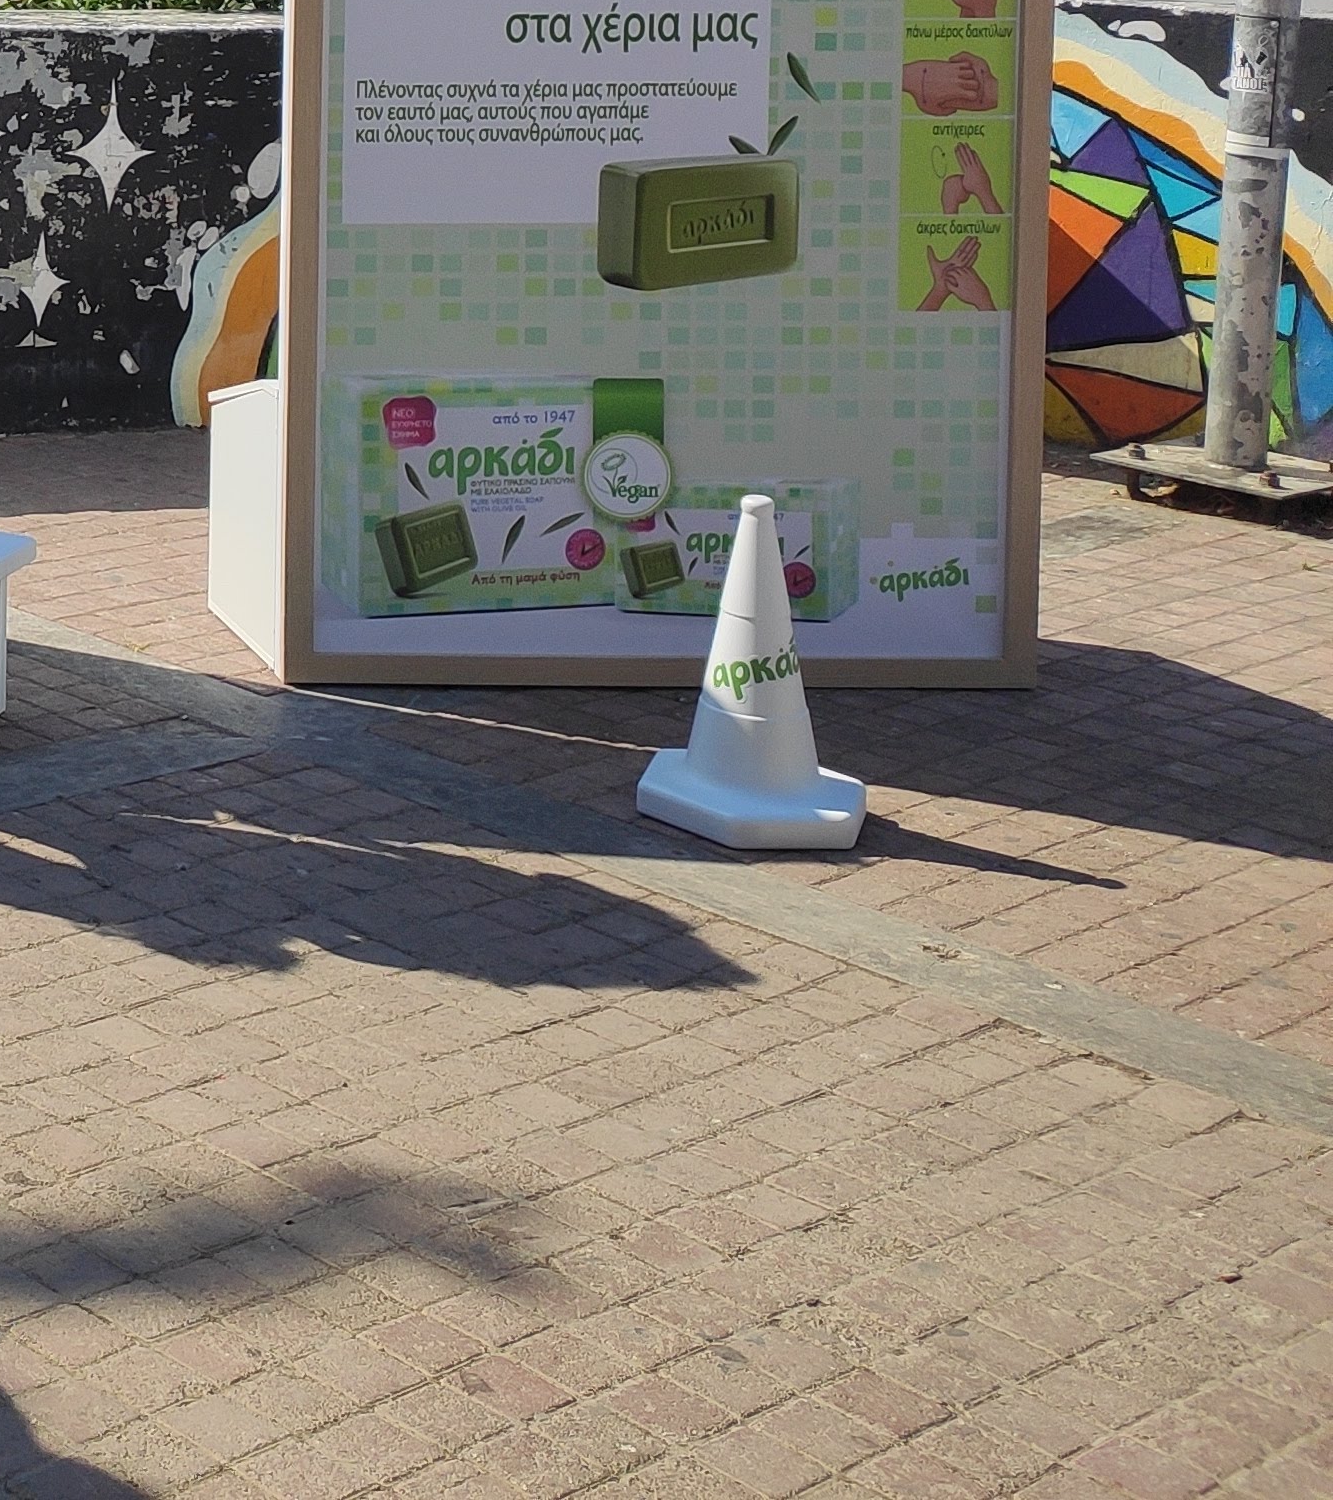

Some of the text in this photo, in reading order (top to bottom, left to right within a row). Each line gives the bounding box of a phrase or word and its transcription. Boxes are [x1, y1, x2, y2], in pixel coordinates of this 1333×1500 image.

[505, 2, 758, 53] στα χέρια μας
[906, 23, 1013, 40] πάνω μέρος δακτύλων
[356, 78, 738, 103] Πλένοντας συχνά τα χέρια μας προστατεύουμε
[355, 101, 650, 124] τον εαυτό μας, αυτούς που αγαπάμε
[355, 122, 644, 146] και όλους τους συνανθρώπους μας.
[933, 121, 985, 138] αντίχειρες
[916, 219, 1001, 236] άκρες δακτύλων
[492, 410, 575, 424] από το 1947
[428, 427, 575, 496] αρκάδι
[602, 475, 659, 503] Vegan
[472, 571, 581, 586] Από τη μαμά φύση
[879, 558, 969, 602] αρκάδι
